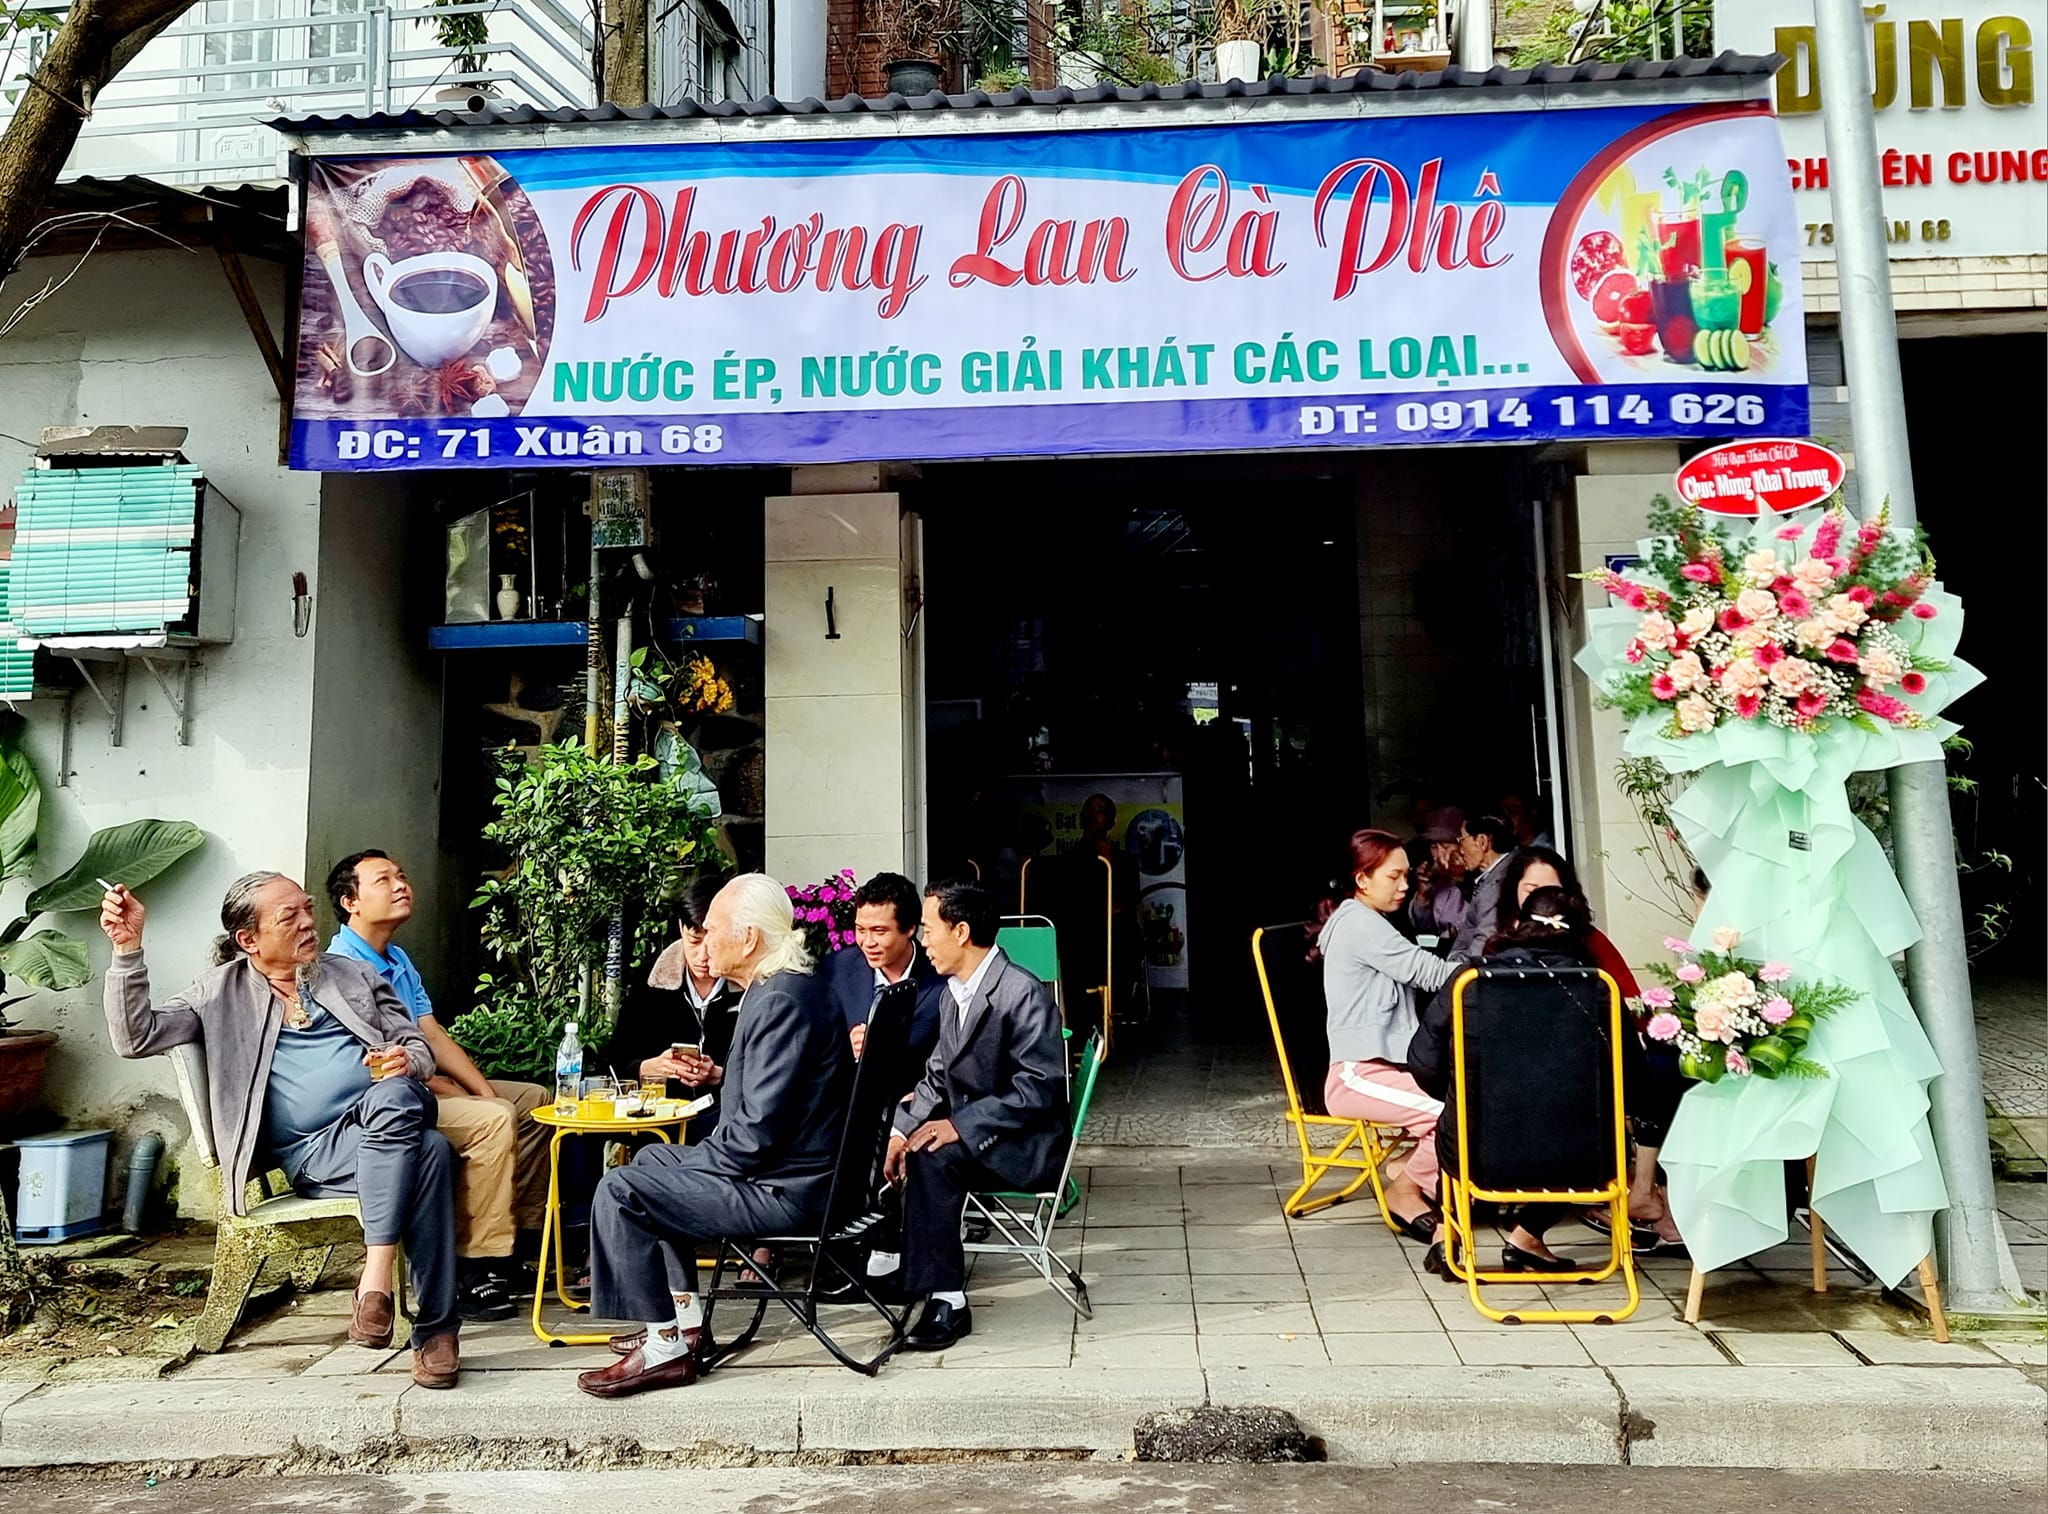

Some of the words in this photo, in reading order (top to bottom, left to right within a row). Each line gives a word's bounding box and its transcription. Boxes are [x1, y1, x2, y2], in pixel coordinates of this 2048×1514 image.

[570, 184, 929, 324] Phương
[948, 174, 1138, 288] Lan
[1165, 163, 1287, 283] Cà
[1313, 156, 1515, 301] Phê
[1804, 223, 1835, 246] 73
[1921, 219, 1952, 241] 68
[553, 353, 694, 403] NƯỚC
[713, 350, 783, 404] ÉP,
[801, 346, 942, 398] NƯỚC
[961, 335, 1062, 394] GIẢI
[1082, 336, 1216, 390] KHÁT
[1233, 332, 1339, 385] CÁC
[1359, 334, 1530, 388] LOẠI...
[1299, 404, 1378, 436] ĐT:
[1395, 397, 1533, 432] 0914
[1551, 394, 1654, 426] 114
[1671, 393, 1766, 426] 626
[336, 427, 421, 461] ĐC:
[437, 428, 491, 458] 71
[514, 425, 643, 457] Xuân
[660, 424, 724, 455] 68
[1754, 468, 1783, 493] Khai
